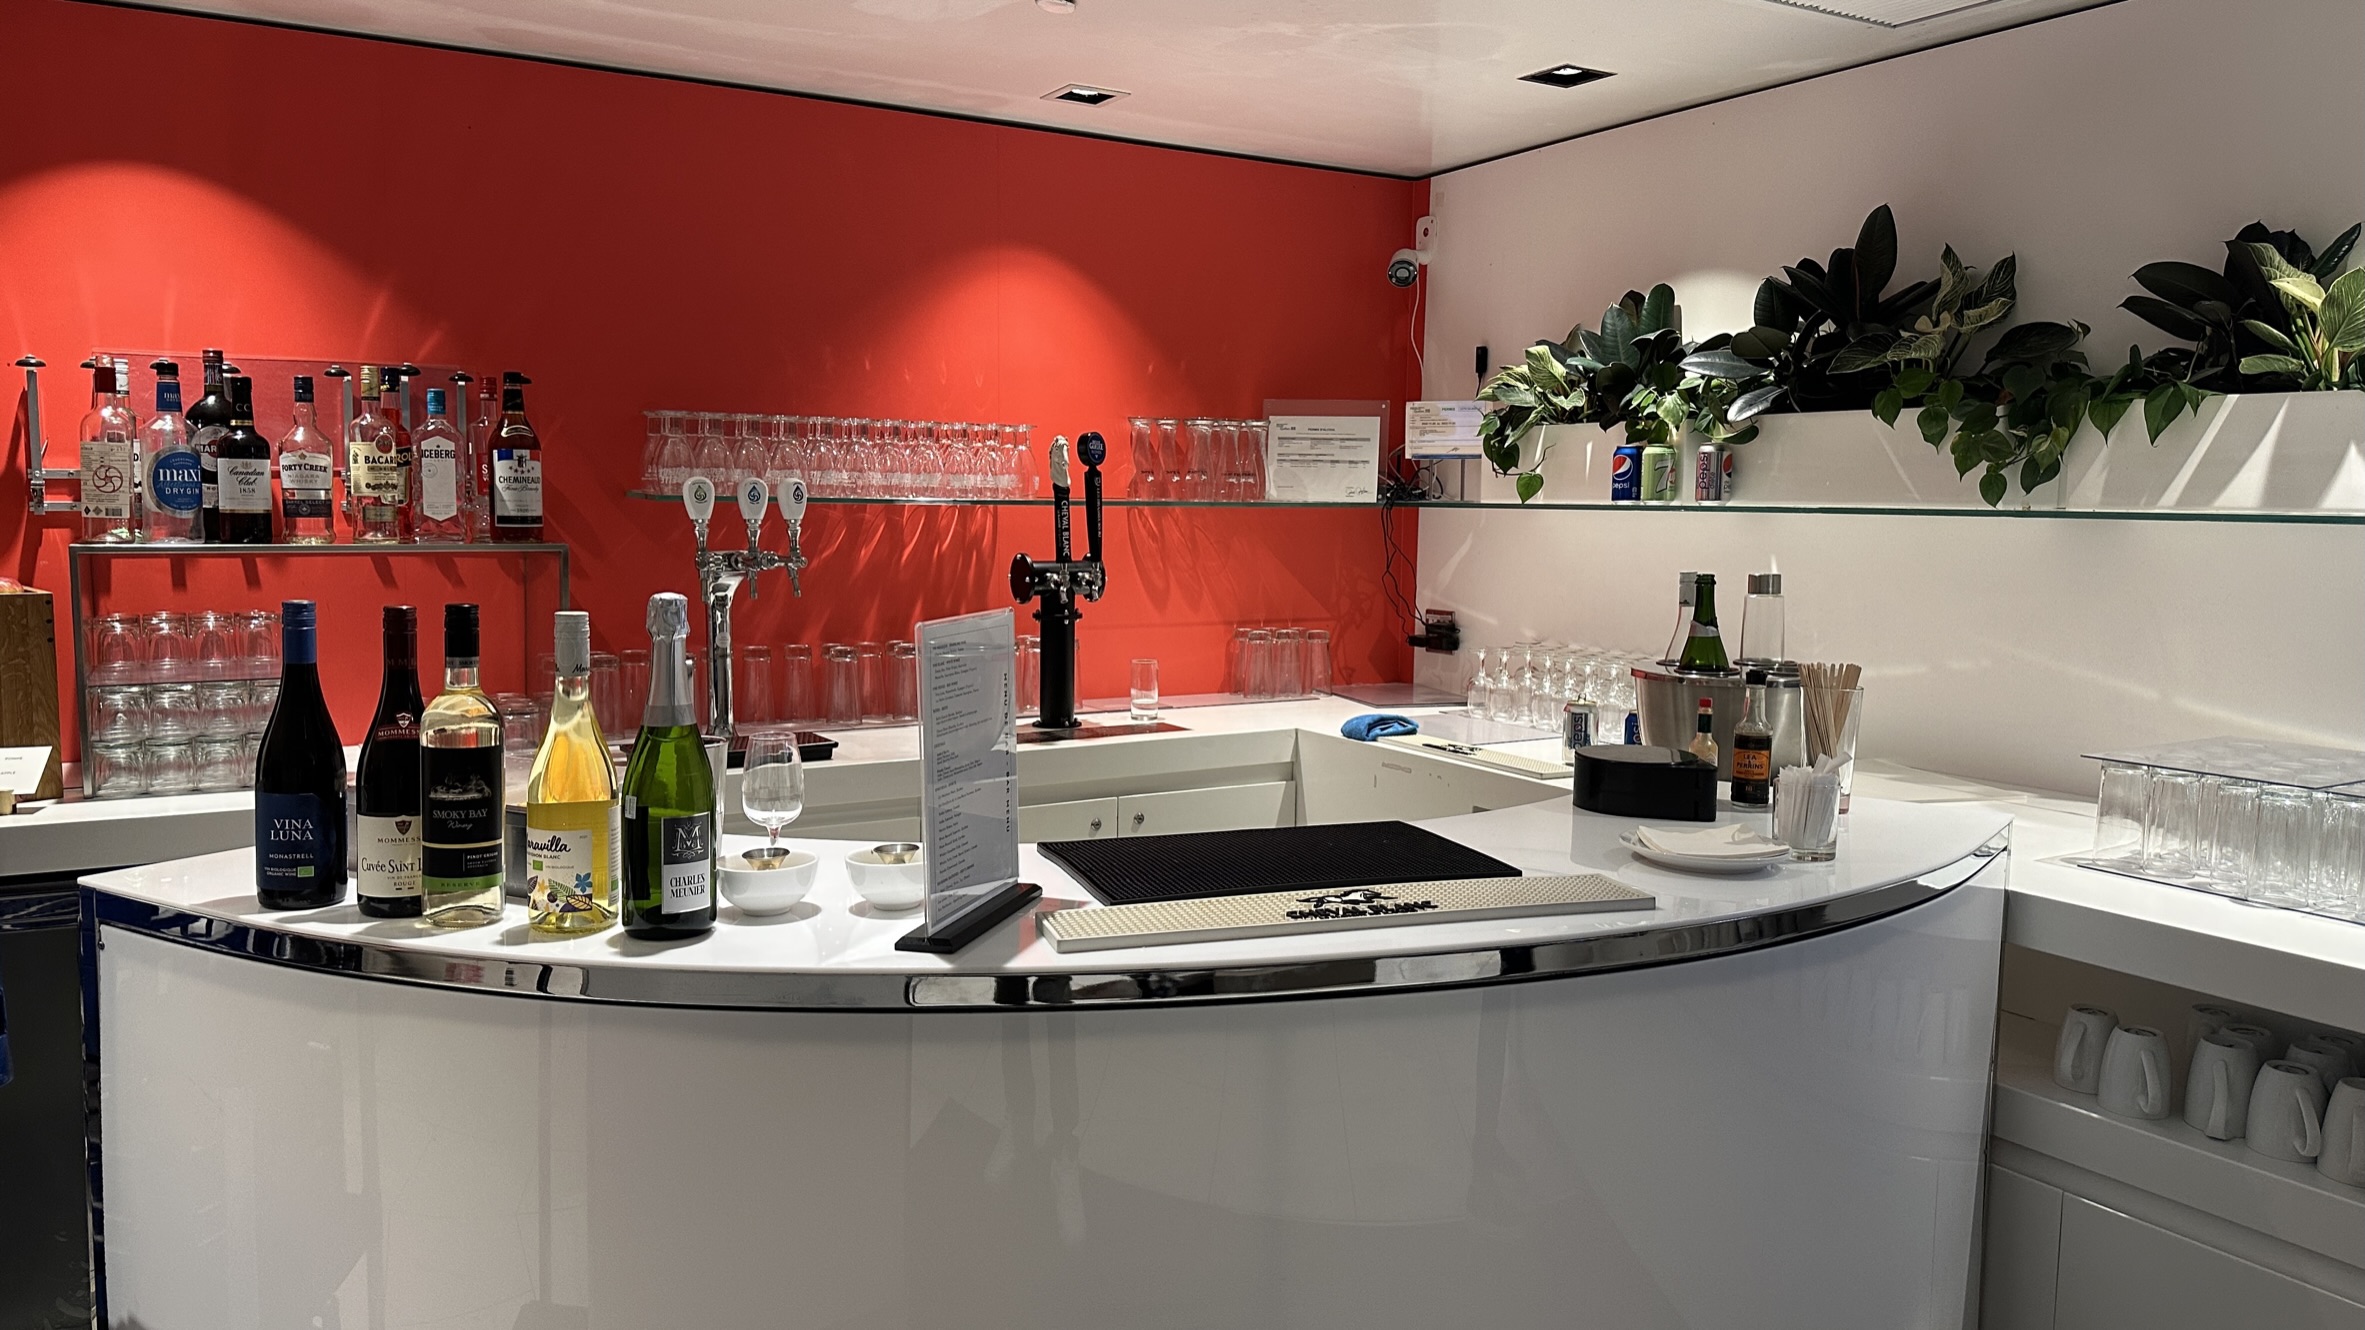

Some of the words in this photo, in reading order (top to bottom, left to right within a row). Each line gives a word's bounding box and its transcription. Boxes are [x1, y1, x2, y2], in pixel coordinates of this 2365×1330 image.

[364, 455, 397, 464] BACAR
[421, 449, 456, 459] ICEBERG
[158, 465, 201, 482] maxi
[228, 466, 265, 477] Canadian
[282, 464, 303, 473] FORTY
[303, 463, 328, 473] CREEK
[236, 476, 257, 486] Club
[1061, 500, 1069, 530] CHEVAL
[1062, 532, 1070, 557] BLANC
[1736, 762, 1764, 770] PERRINS
[432, 810, 468, 819] SMOKY
[469, 808, 488, 818] BAY
[270, 830, 314, 841] LUNA
[377, 836, 421, 844] MOMMESS
[361, 857, 386, 872] Cuvée
[669, 873, 705, 888] CHARLES
[670, 884, 705, 899] MEUNIER
